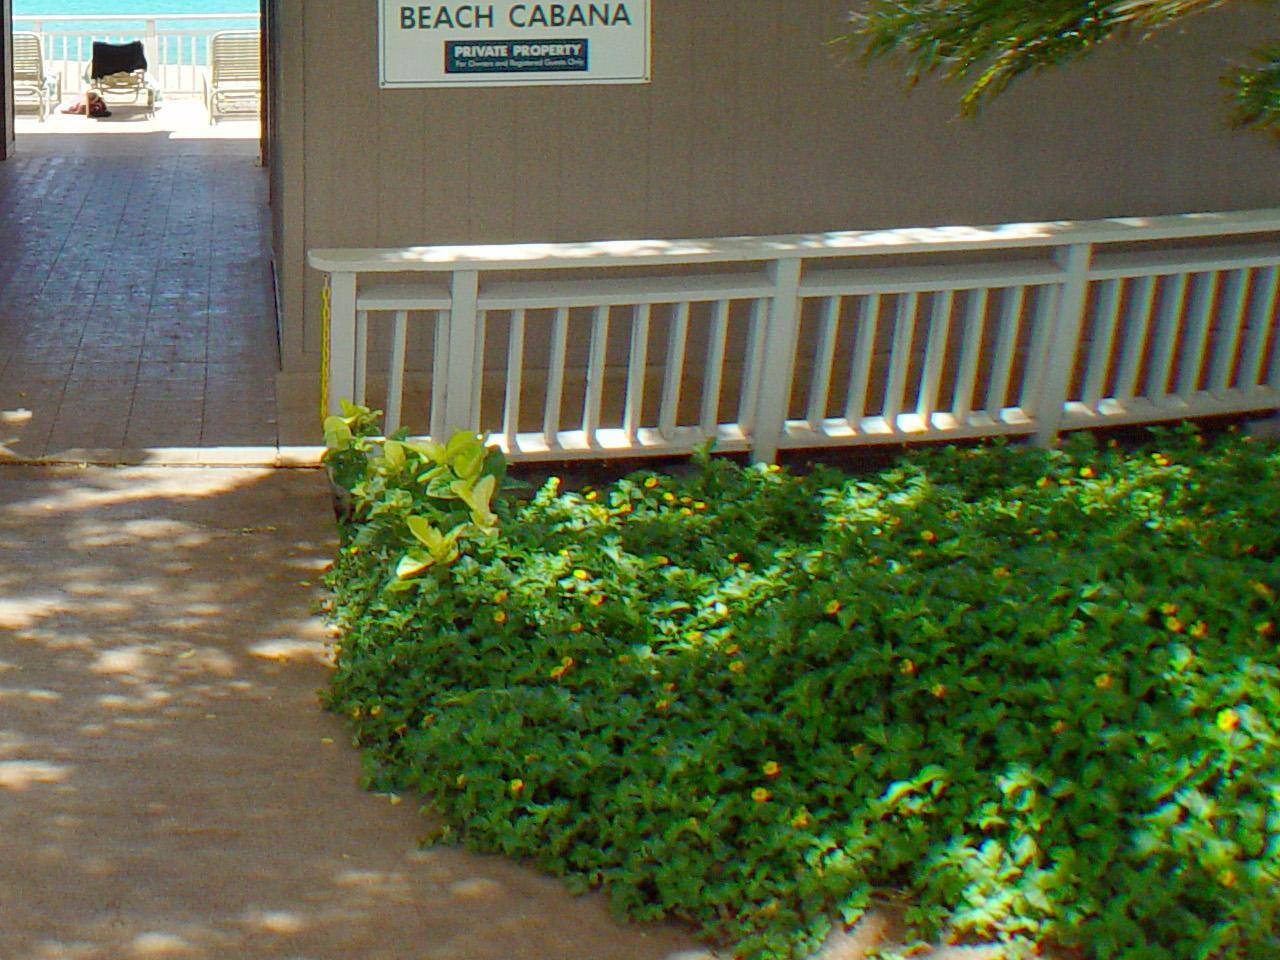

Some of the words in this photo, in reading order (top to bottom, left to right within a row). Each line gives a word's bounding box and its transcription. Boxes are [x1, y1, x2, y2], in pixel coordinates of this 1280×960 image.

[400, 5, 494, 29] BEACH
[509, 3, 632, 27] CABANA
[454, 46, 508, 58] PRIVATE
[513, 44, 581, 57] PROPERTY
